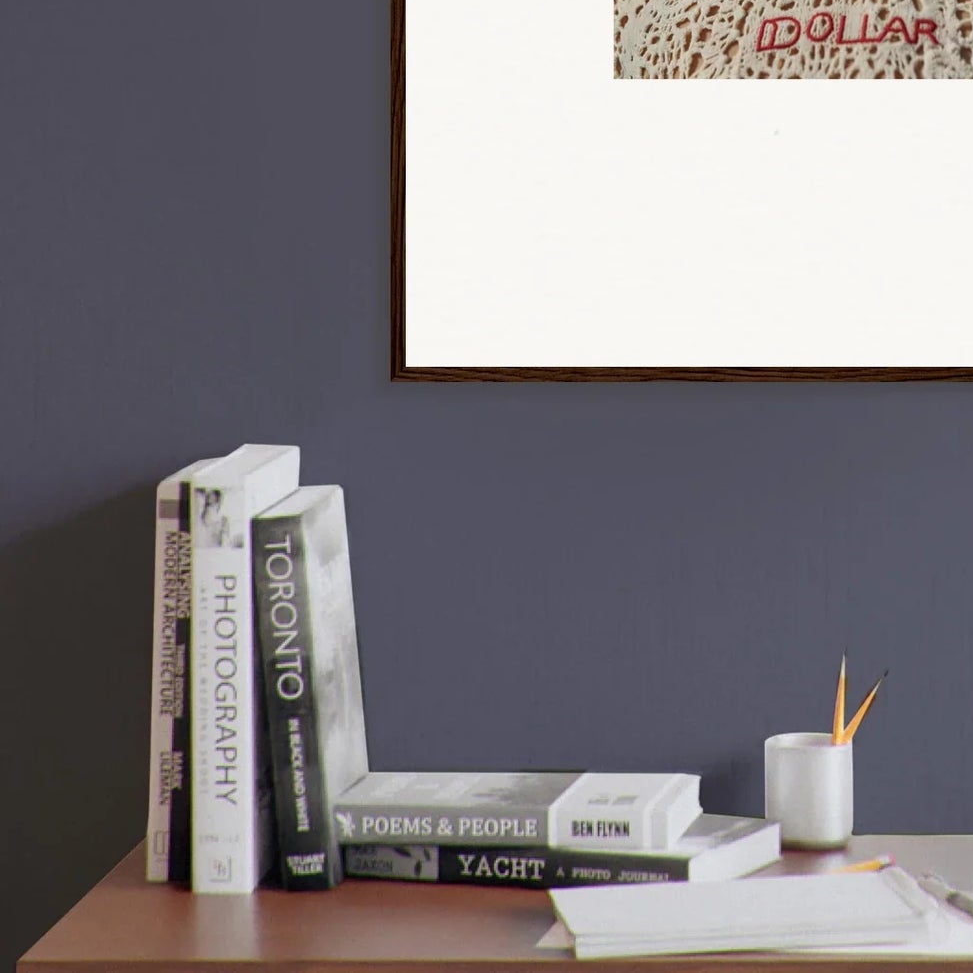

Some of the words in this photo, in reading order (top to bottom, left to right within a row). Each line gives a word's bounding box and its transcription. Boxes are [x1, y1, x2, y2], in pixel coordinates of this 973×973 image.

[163, 530, 177, 598] MODERN
[263, 534, 304, 700] TORONTO
[160, 605, 176, 717] ARCHITECTURE
[214, 574, 238, 806] PHOTOGRAPHY
[292, 770, 306, 796] AND
[361, 815, 432, 836] POEMS
[438, 816, 454, 836] &
[458, 817, 538, 838] PEOPLE
[571, 820, 594, 838] BEN
[596, 820, 631, 839] FLYNN
[457, 853, 545, 880] YACHT
[555, 867, 565, 877] A
[571, 867, 612, 881] PHOTO
